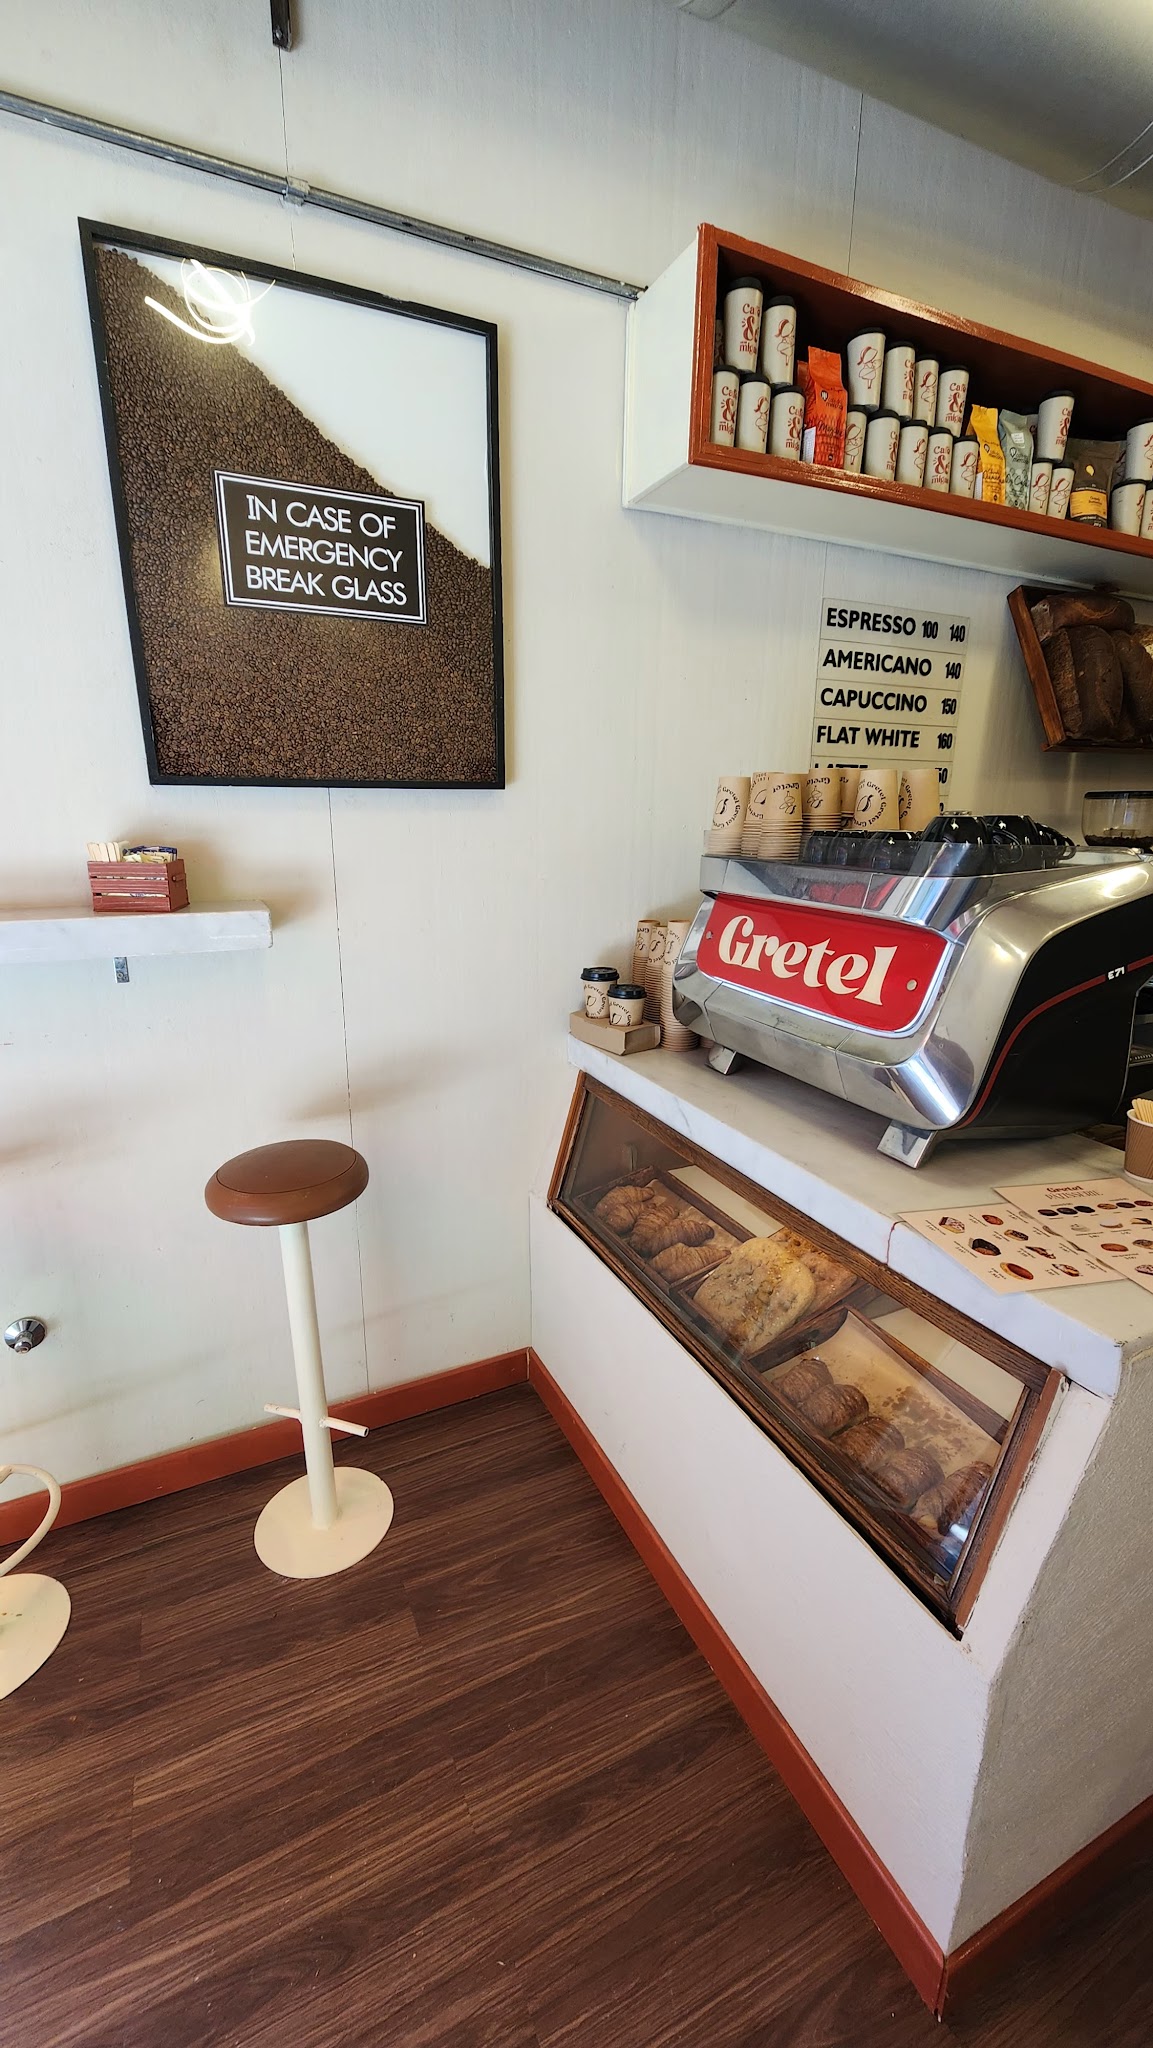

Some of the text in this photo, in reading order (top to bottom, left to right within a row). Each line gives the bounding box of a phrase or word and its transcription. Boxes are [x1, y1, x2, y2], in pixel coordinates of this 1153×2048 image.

[246, 494, 396, 539] IN CASE OF
[245, 529, 403, 573] EMERGENCY
[245, 564, 407, 606] BREAK GLASS
[826, 607, 966, 643] ESPRESSO 100 140
[822, 648, 962, 680] AMERICANO 140
[820, 687, 957, 715] CAPUCCINO 150
[816, 725, 953, 749] FLAT WHITE 160
[718, 915, 898, 1006] Gretel
[1107, 966, 1125, 980] E71
